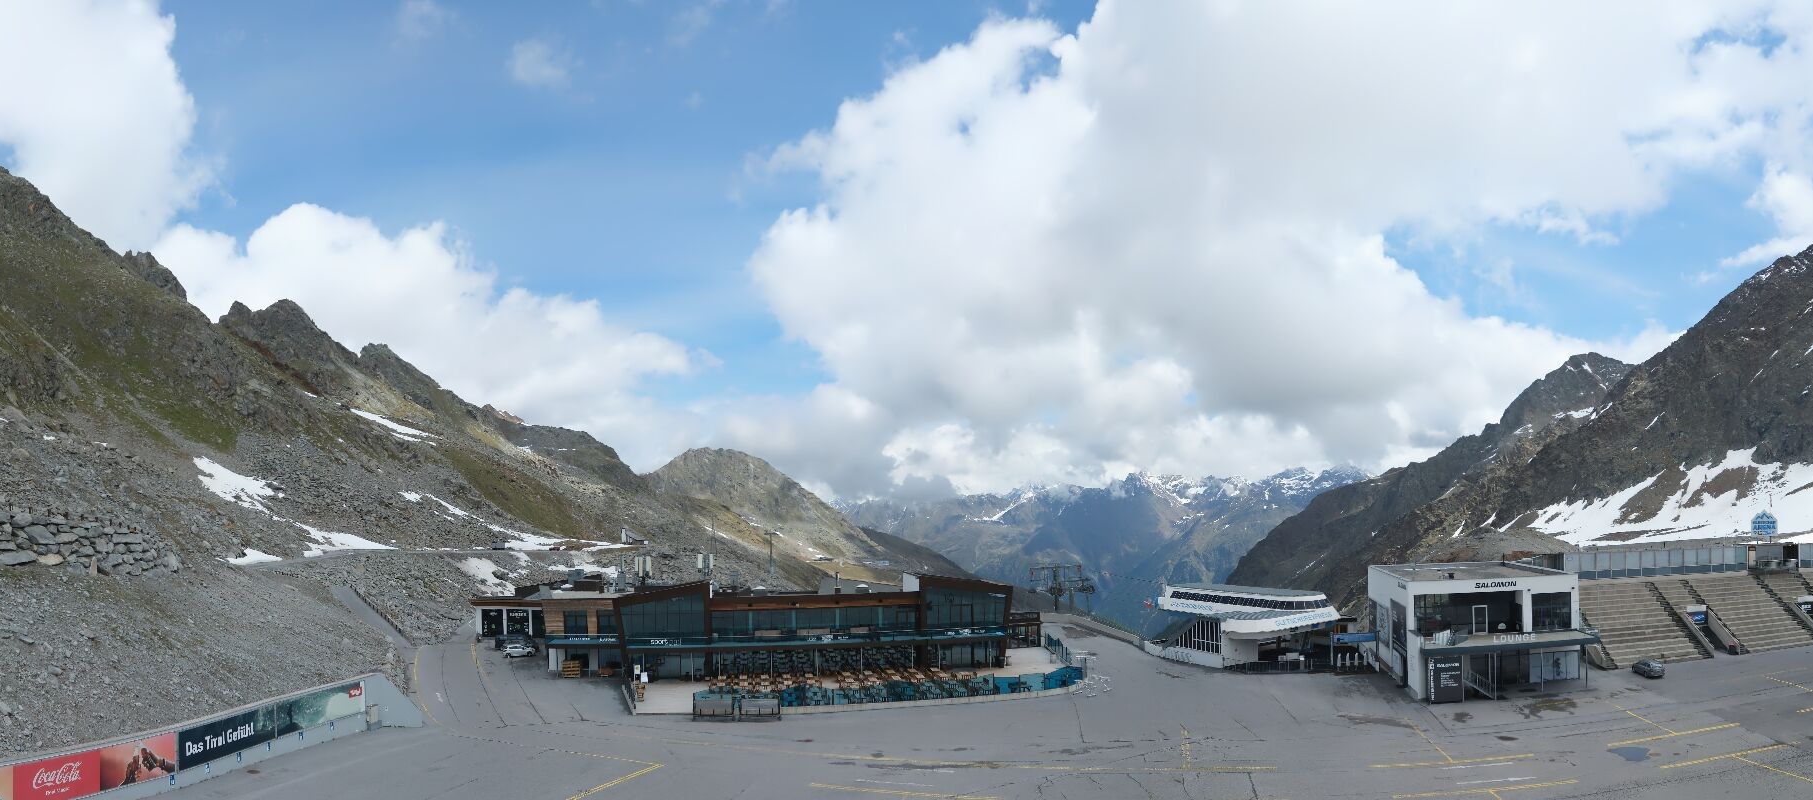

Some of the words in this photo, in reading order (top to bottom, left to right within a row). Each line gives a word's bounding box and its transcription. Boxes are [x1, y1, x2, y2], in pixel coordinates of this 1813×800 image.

[1474, 581, 1517, 589] SALOMON
[1493, 633, 1536, 643] LOUNGE
[185, 741, 204, 757] Das
[204, 731, 226, 750] Tirol
[226, 722, 255, 743] Gefühl
